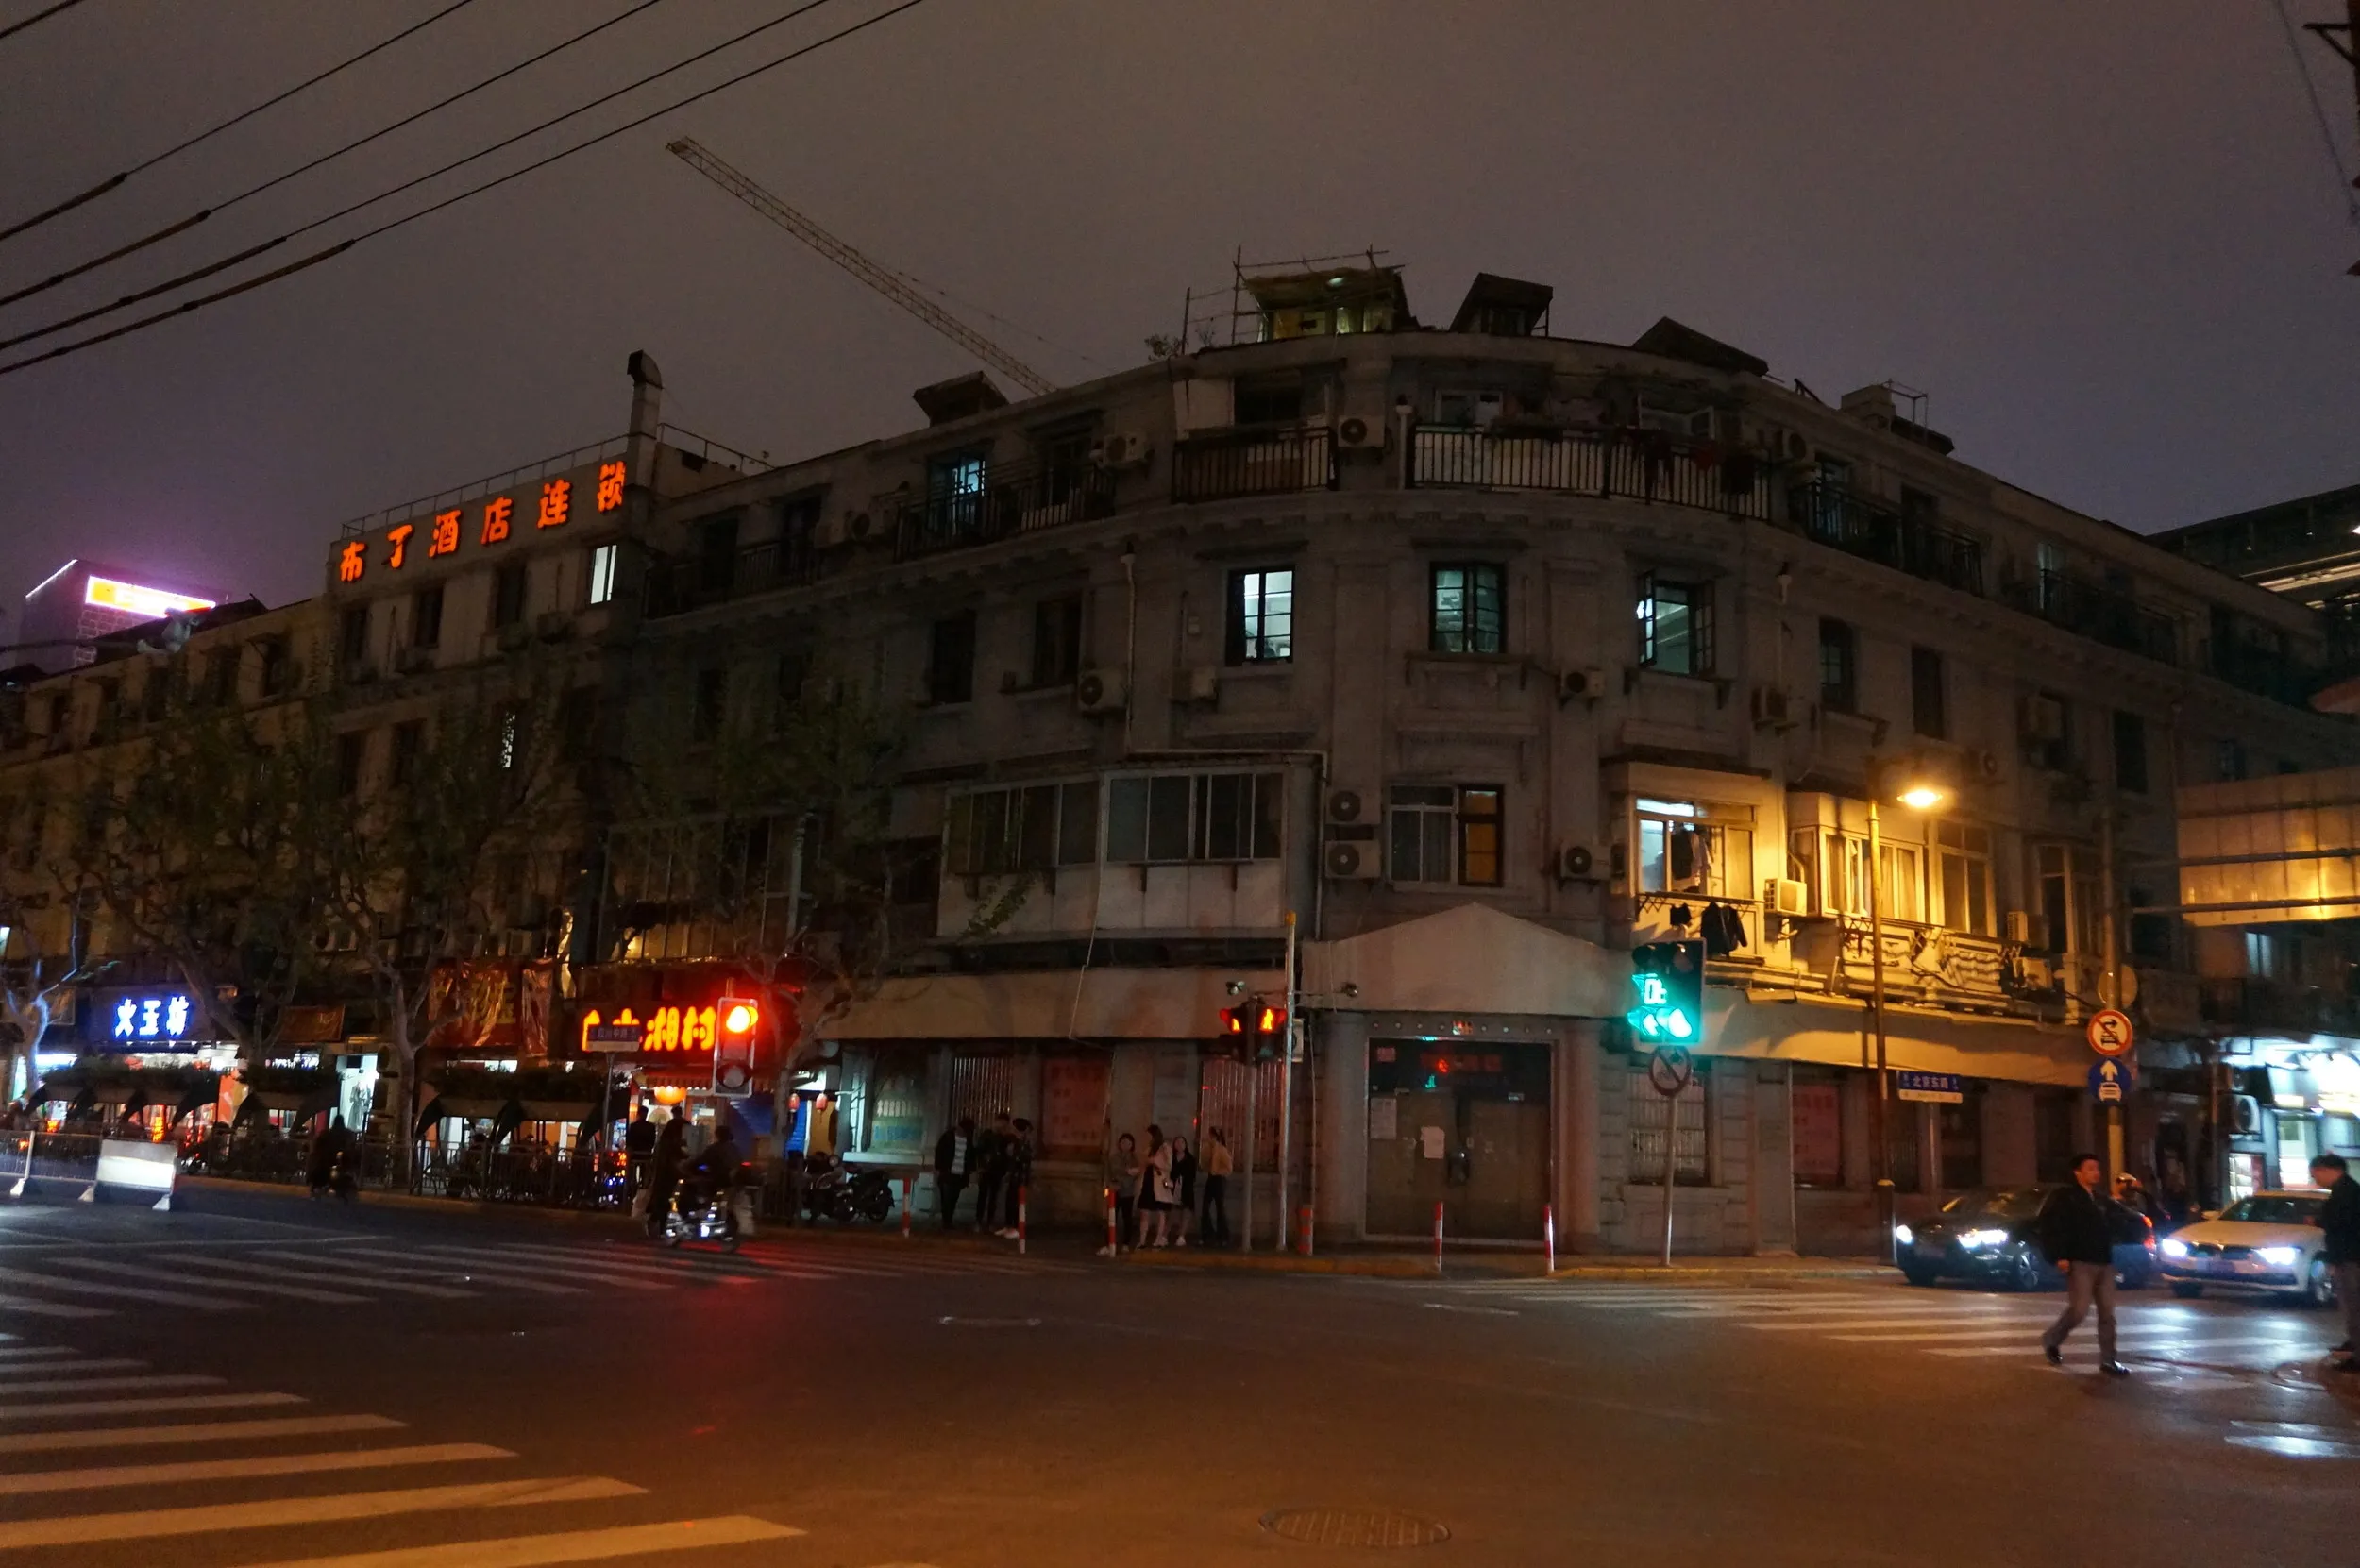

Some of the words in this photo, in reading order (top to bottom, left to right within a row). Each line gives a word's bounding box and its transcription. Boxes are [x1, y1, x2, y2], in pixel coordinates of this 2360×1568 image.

[339, 460, 627, 582] 布丁酒店连锁
